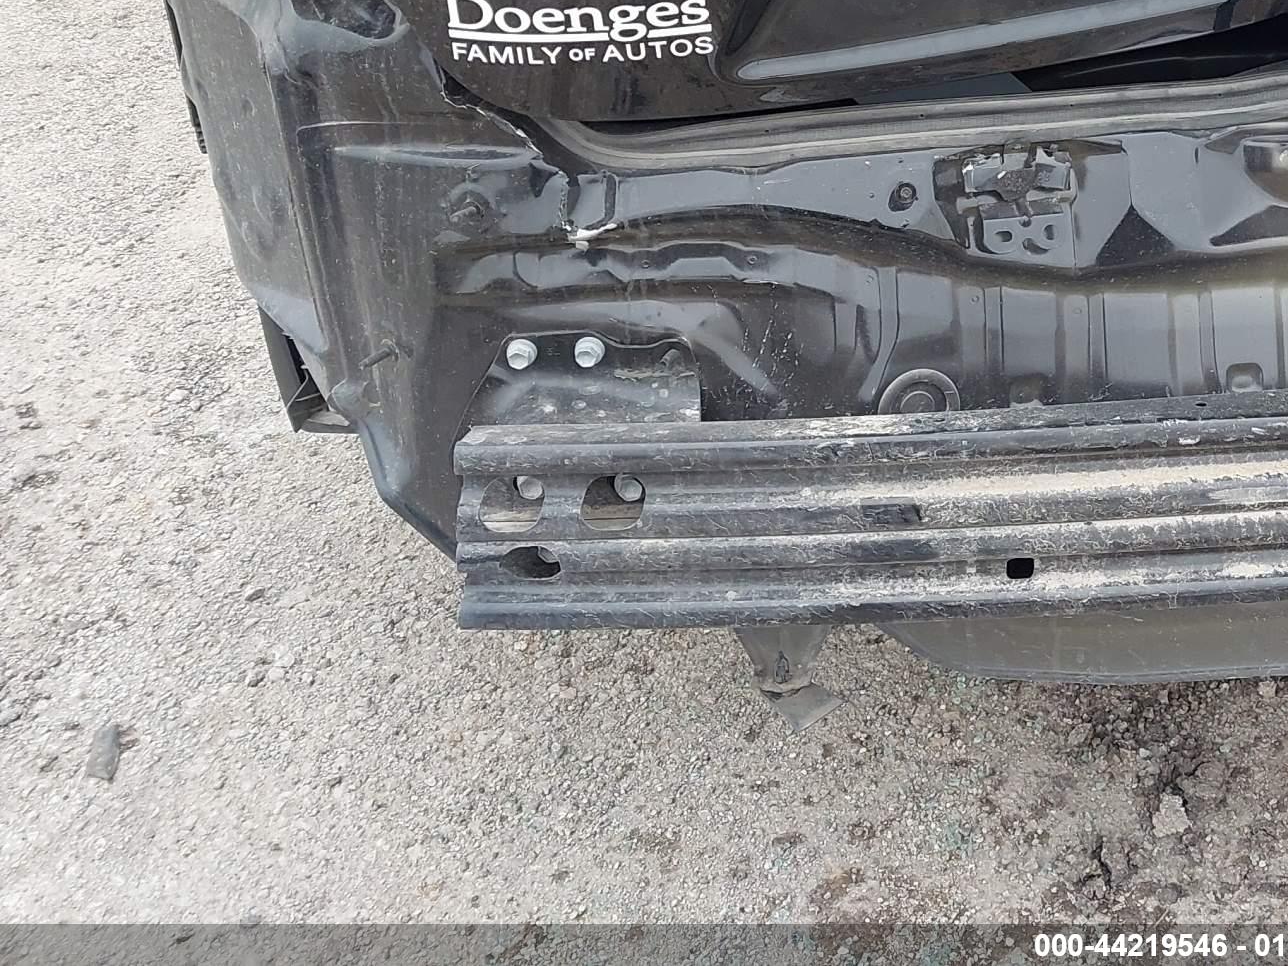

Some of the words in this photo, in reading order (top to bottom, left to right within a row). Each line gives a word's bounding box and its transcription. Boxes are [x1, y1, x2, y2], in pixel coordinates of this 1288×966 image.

[451, 42, 562, 65] FAMILY
[569, 48, 596, 62] OF
[602, 36, 714, 63] AUTOS
